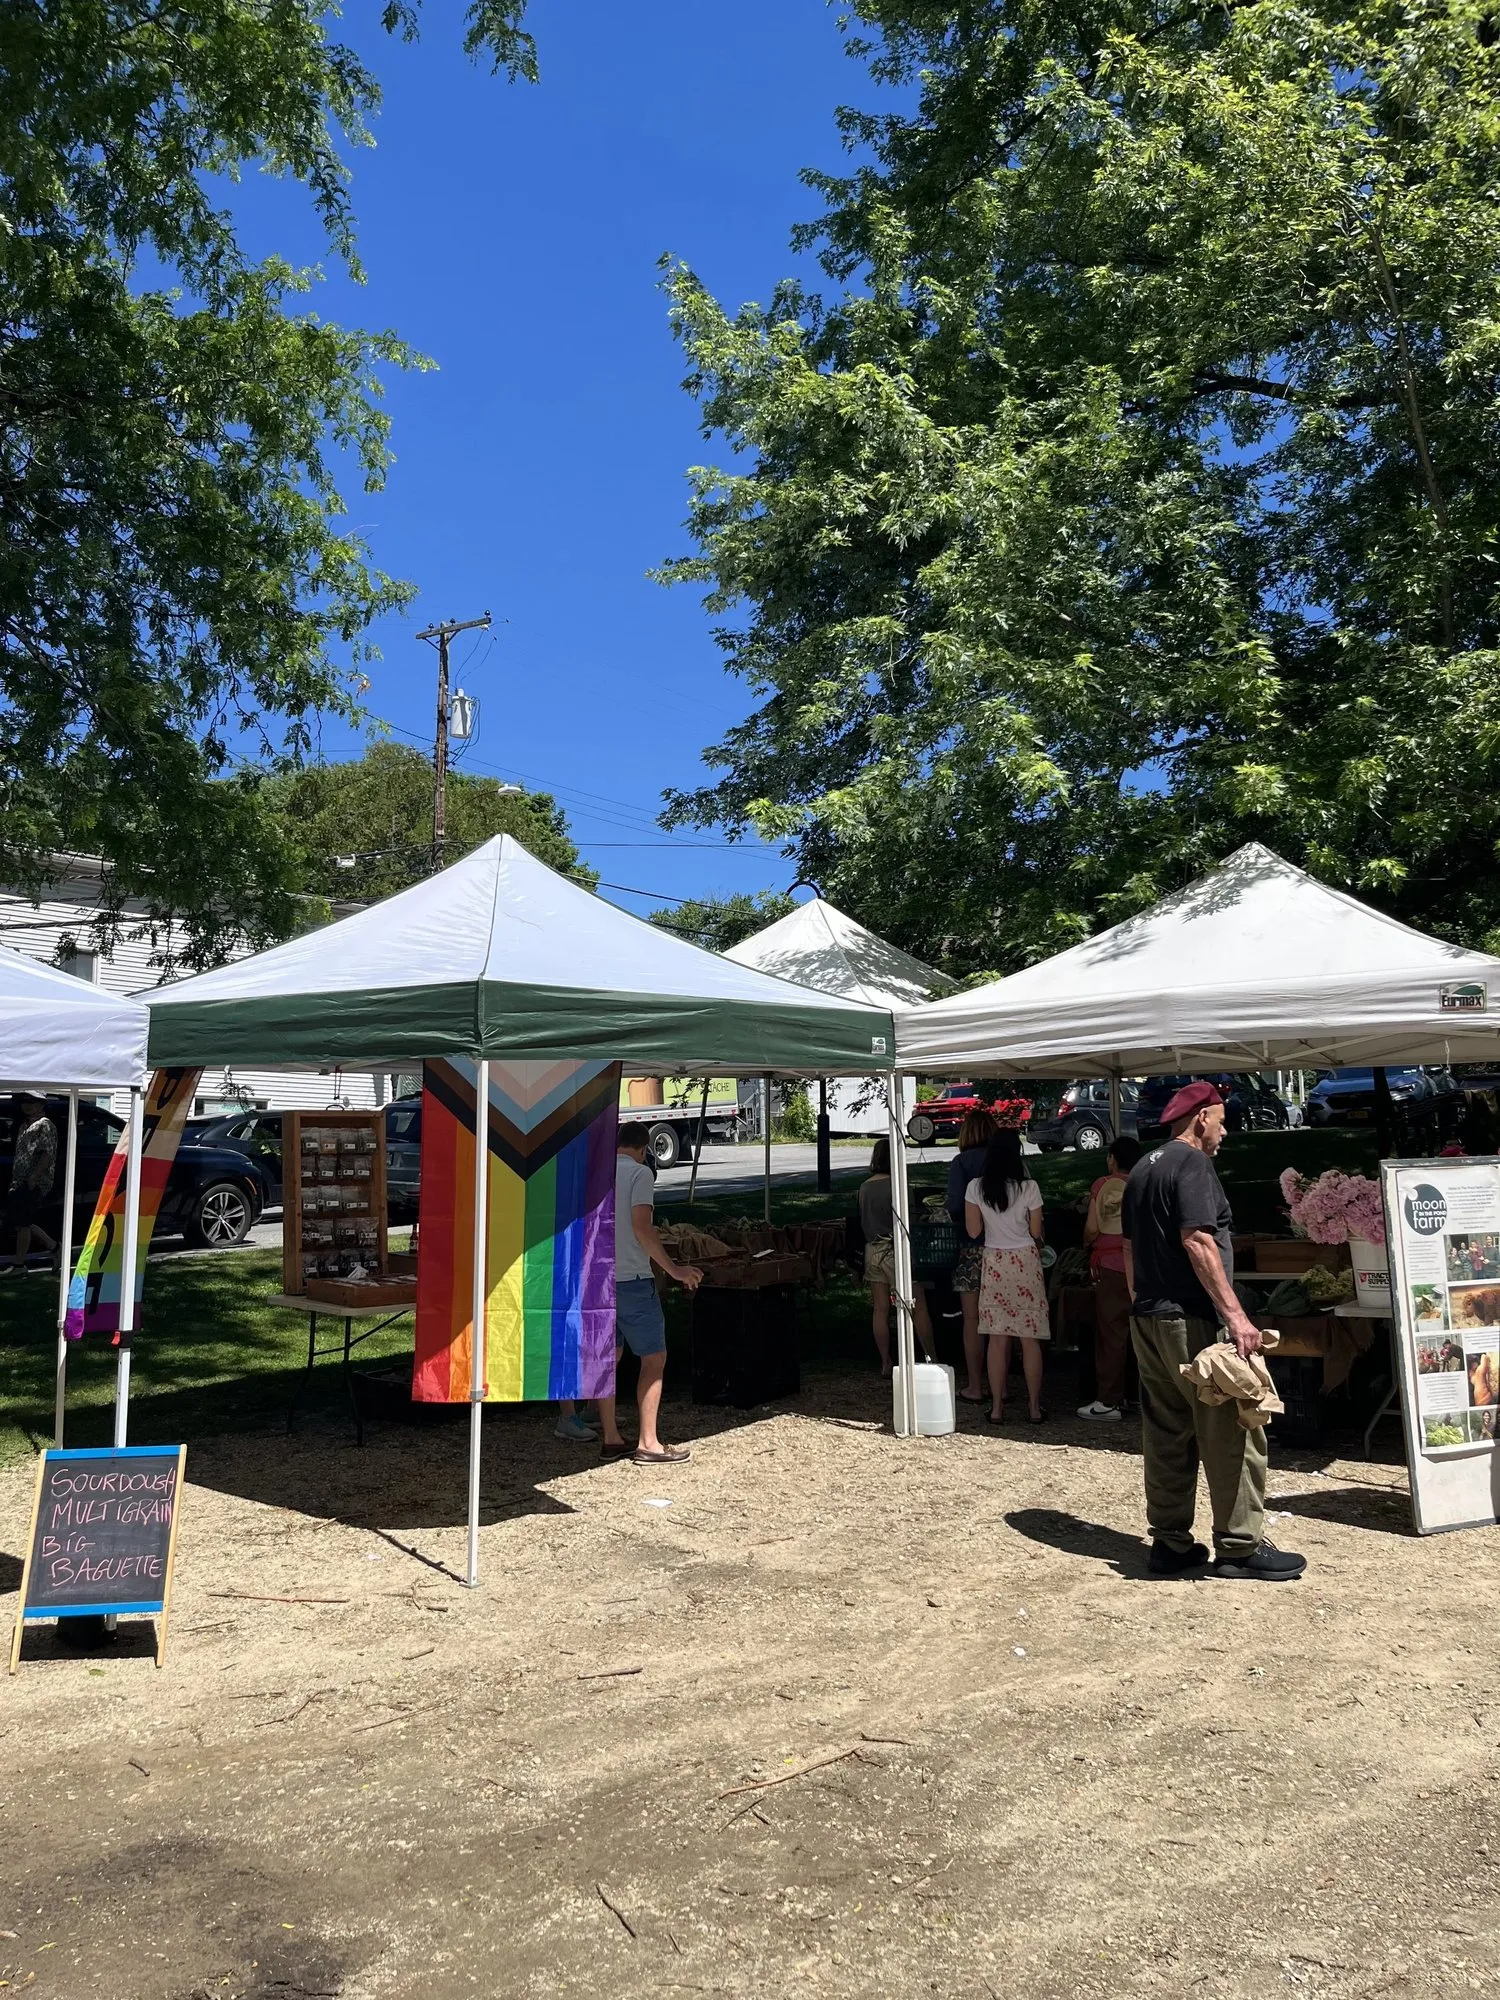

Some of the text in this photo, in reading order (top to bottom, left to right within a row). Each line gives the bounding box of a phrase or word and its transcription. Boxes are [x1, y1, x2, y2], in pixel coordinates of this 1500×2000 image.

[1441, 994, 1482, 1007] Eurmax
[1412, 1200, 1446, 1211] moon
[1413, 1210, 1446, 1229] farm
[51, 1467, 176, 1498] SOURDOUGH
[51, 1555, 164, 1586] BAGUETTE
